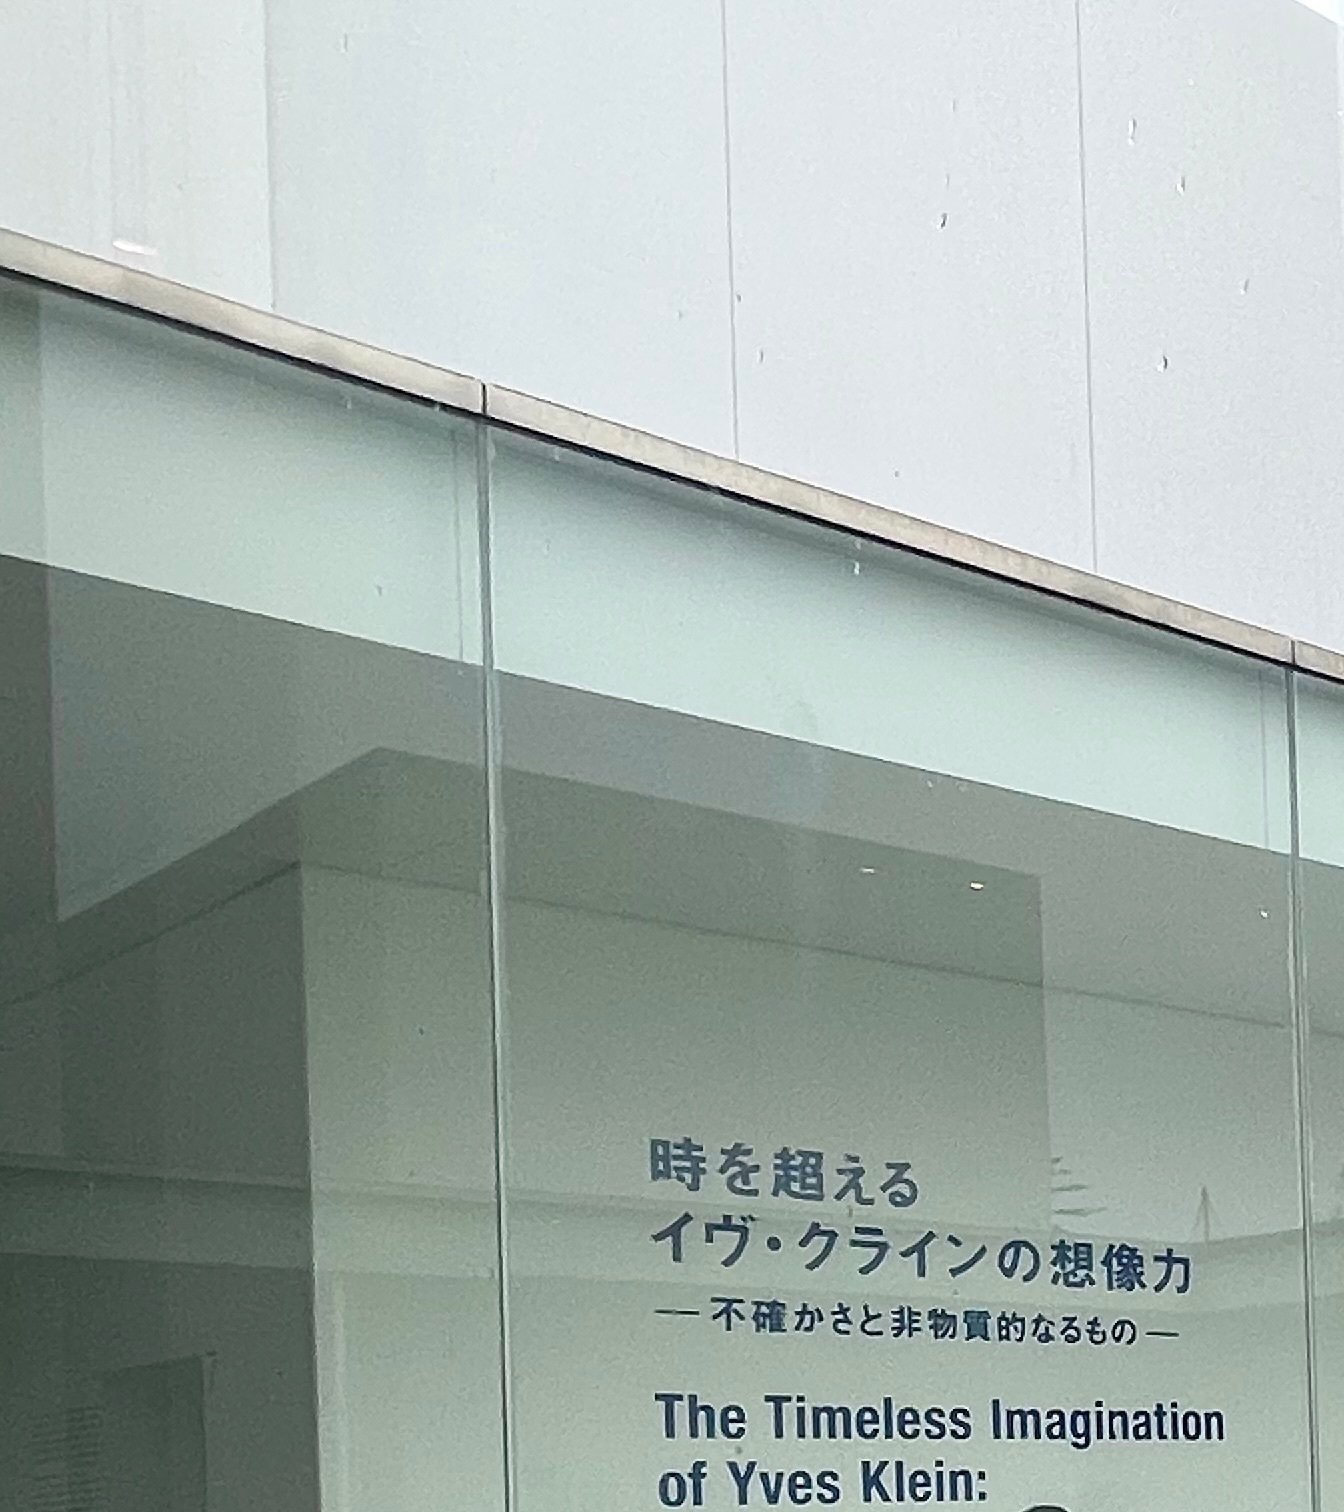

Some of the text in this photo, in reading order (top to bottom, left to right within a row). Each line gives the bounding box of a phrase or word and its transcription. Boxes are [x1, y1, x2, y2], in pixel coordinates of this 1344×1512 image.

[651, 1137, 919, 1208] 時を超える
[651, 1212, 1191, 1294] イヴ・クラインの想像力
[655, 1392, 1225, 1450] The Timeless Imagination
[658, 1460, 987, 1506] of Yves Klein:
